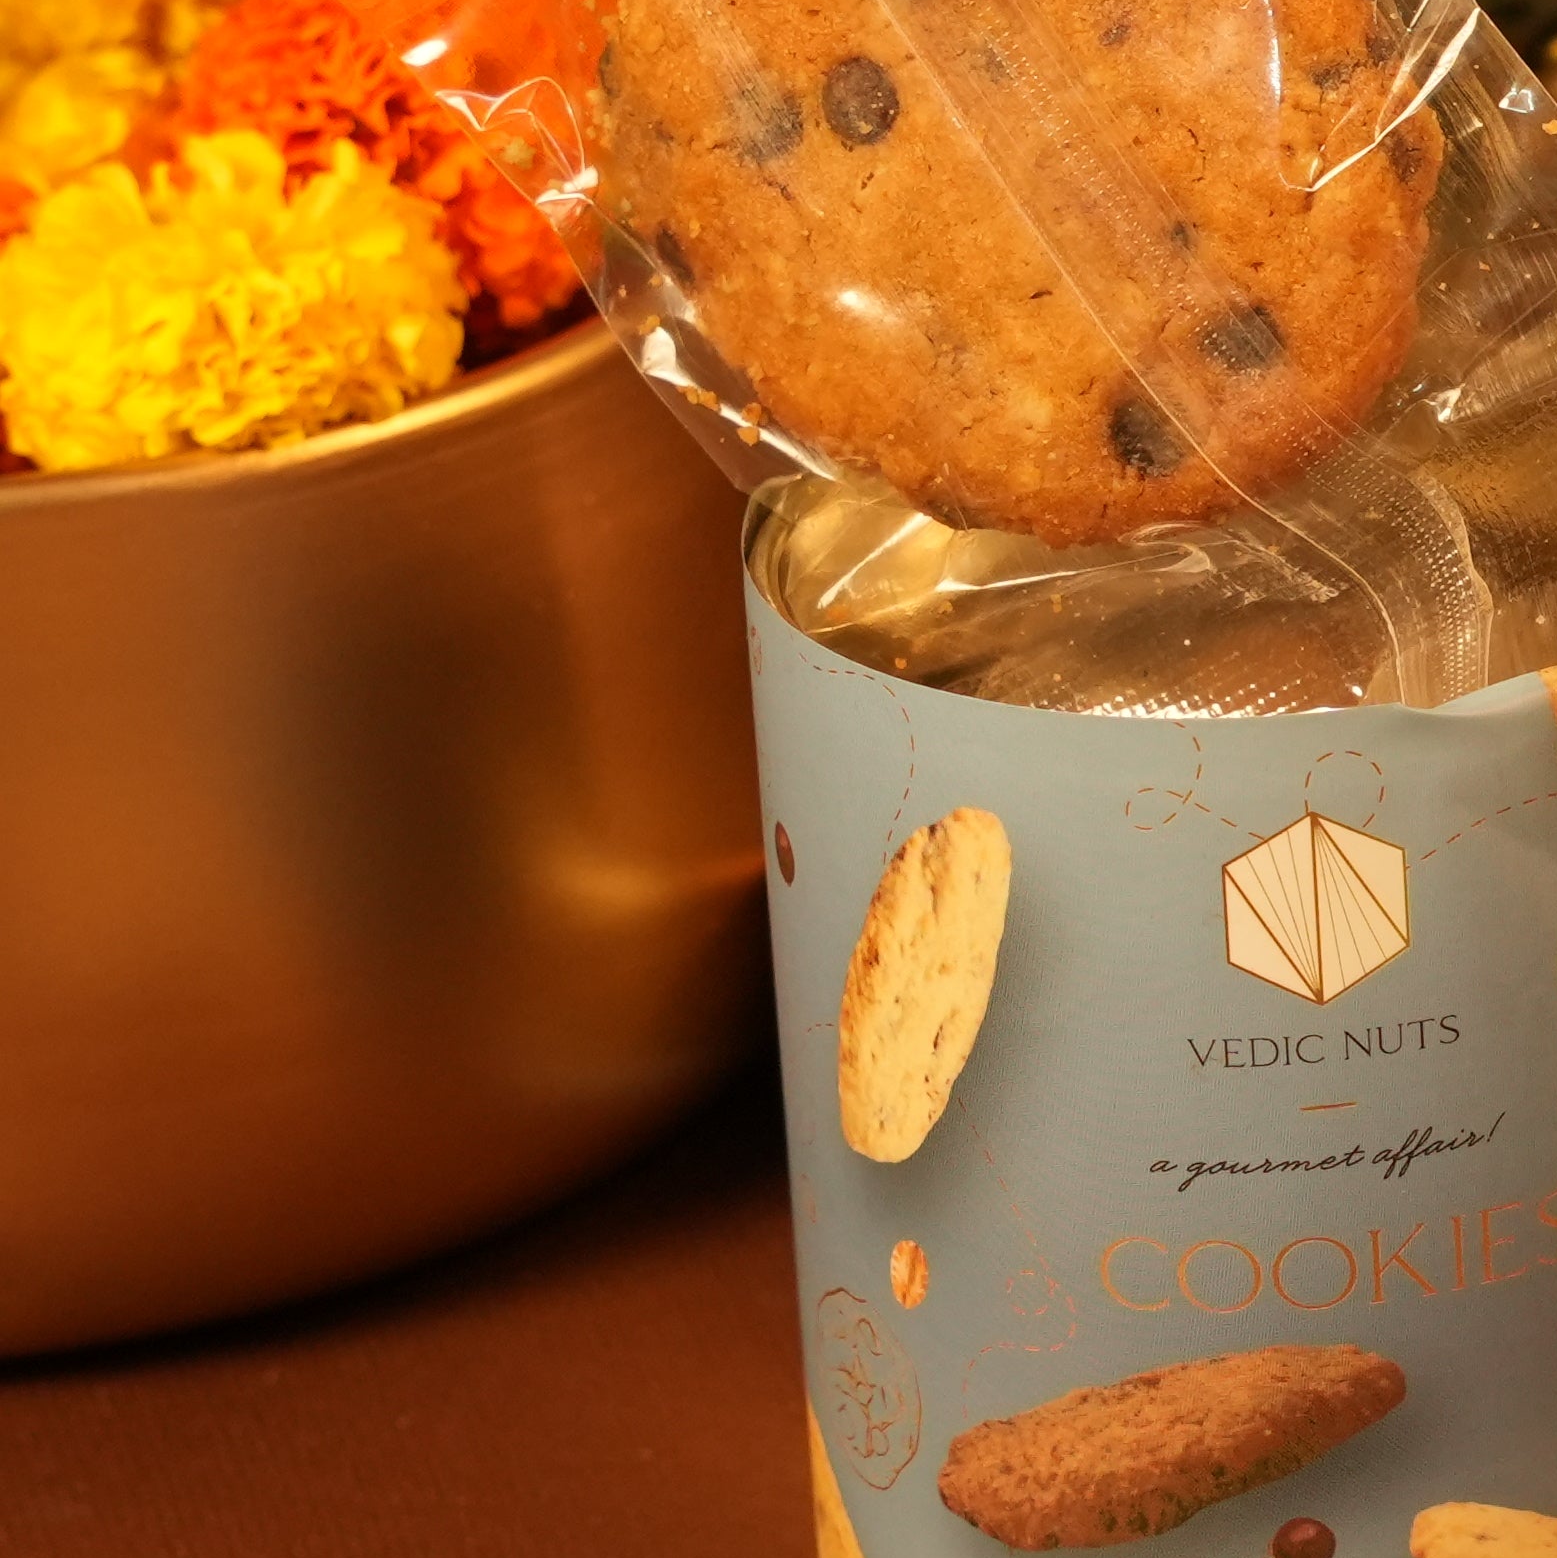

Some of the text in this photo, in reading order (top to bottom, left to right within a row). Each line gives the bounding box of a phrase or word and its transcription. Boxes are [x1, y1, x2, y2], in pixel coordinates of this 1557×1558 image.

[1187, 1014, 1460, 1068] VEDIC NUTS
[1150, 1111, 1505, 1192] a gourmet affair!
